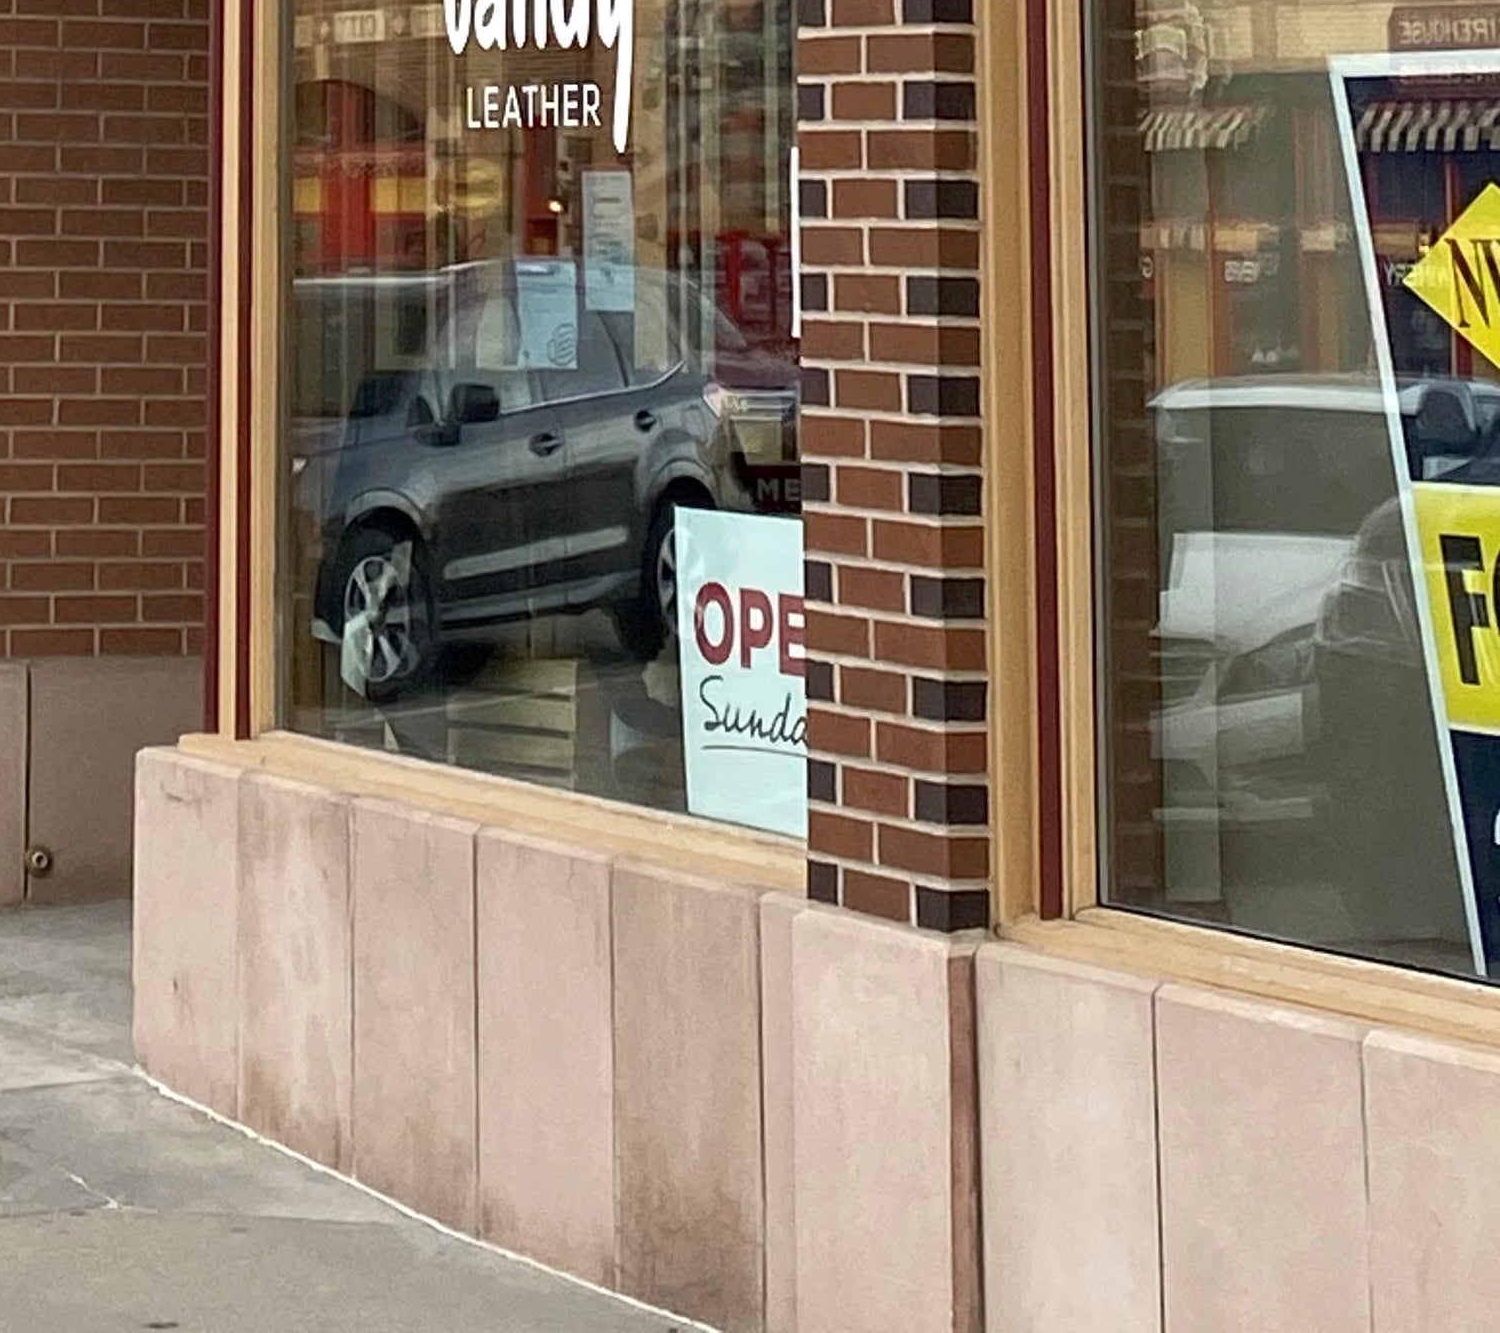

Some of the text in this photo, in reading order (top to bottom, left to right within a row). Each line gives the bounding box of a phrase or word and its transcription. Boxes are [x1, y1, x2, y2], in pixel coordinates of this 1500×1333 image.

[465, 83, 602, 129] LEATHER
[693, 581, 805, 678] OPE
[699, 674, 807, 745] Sunda
